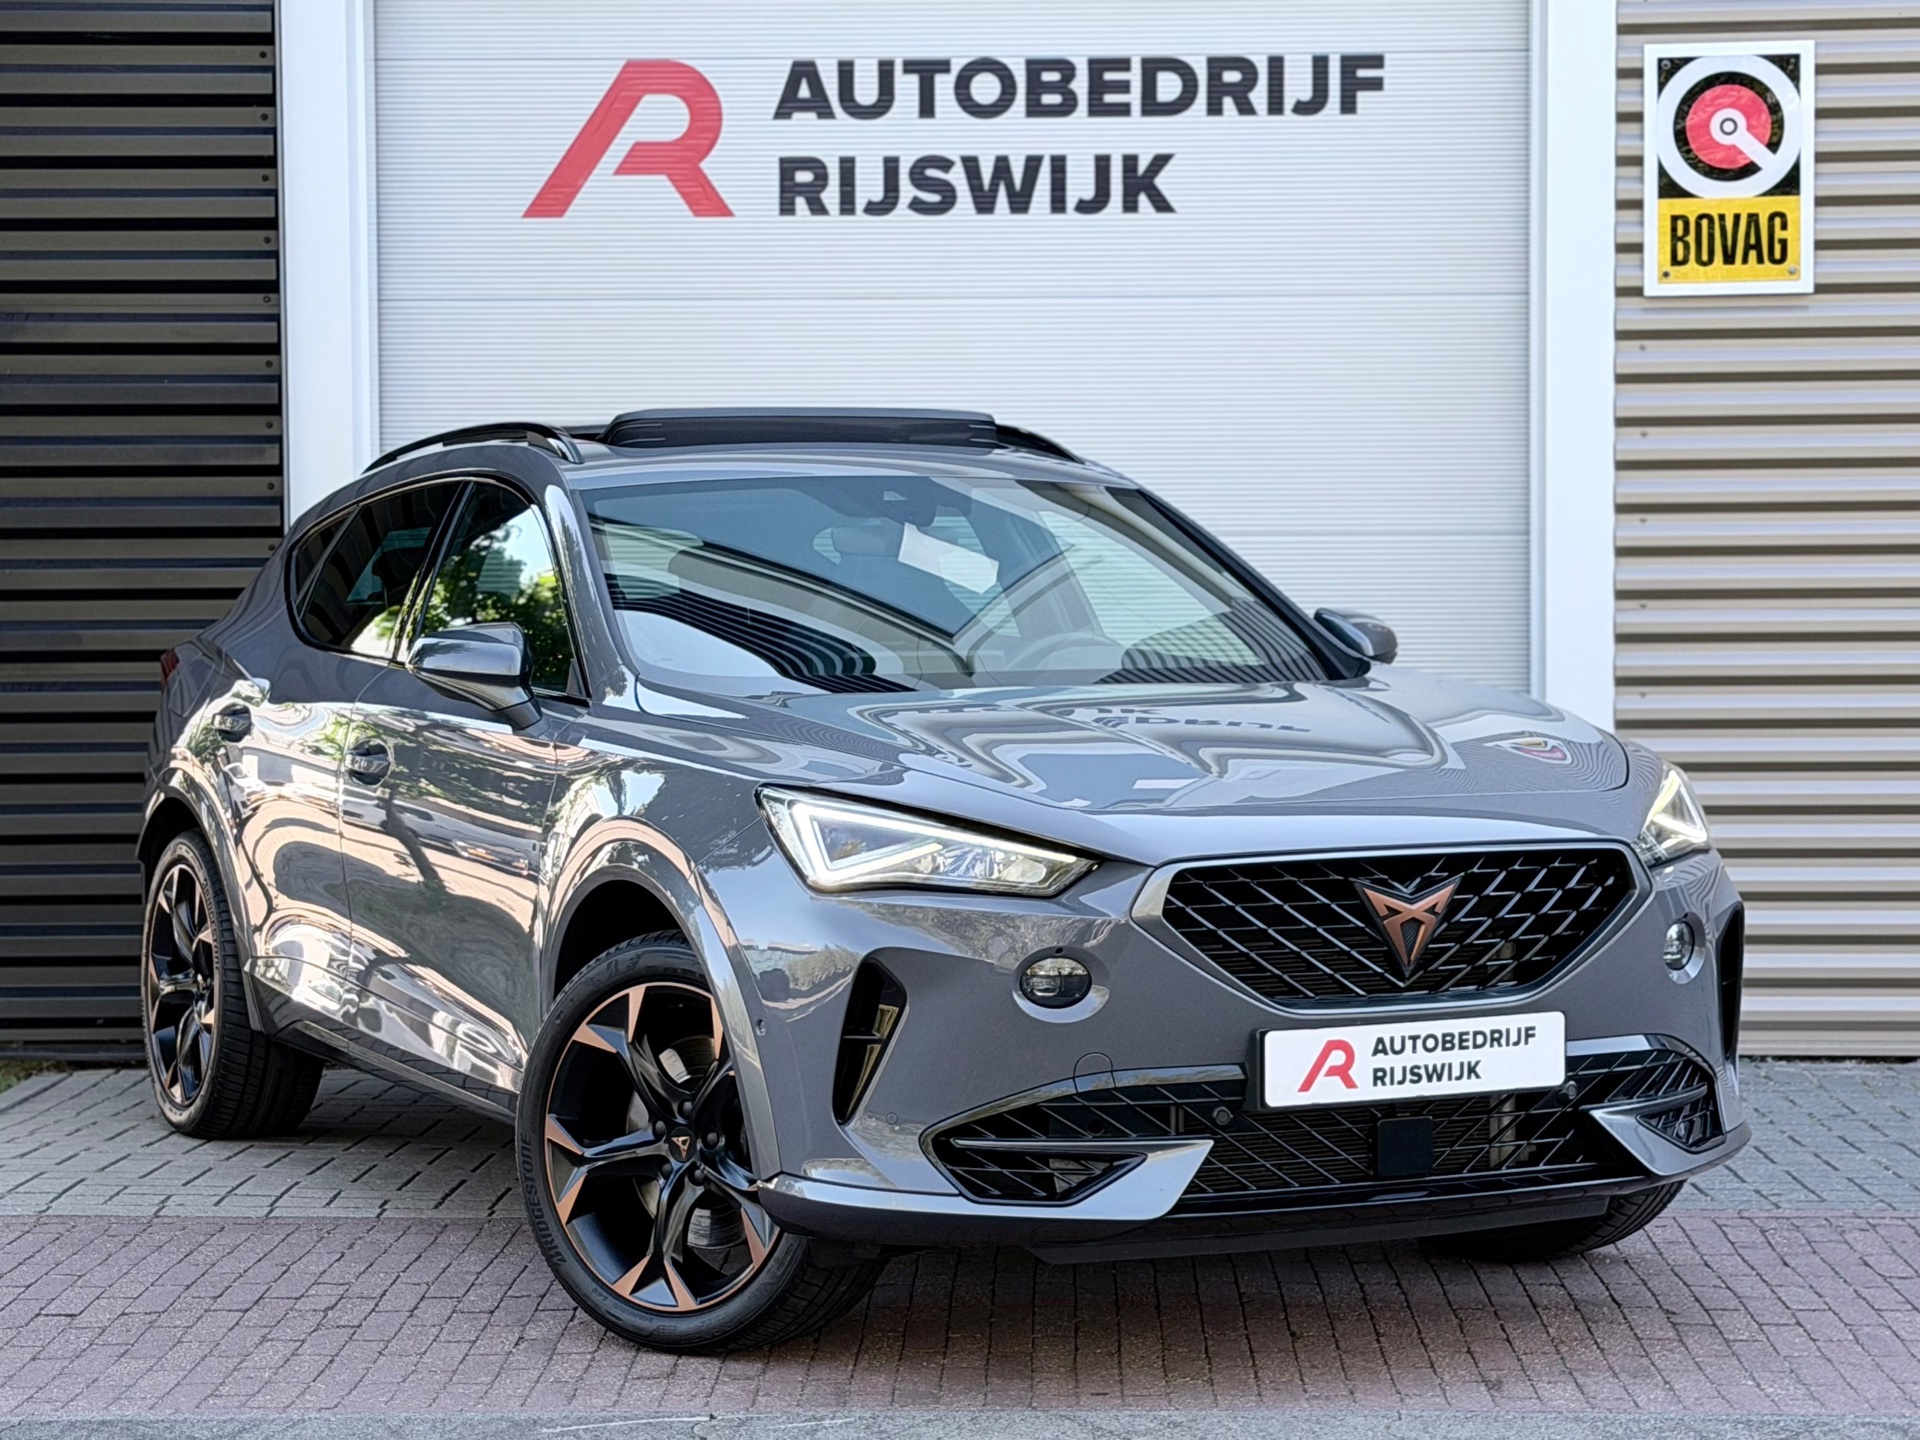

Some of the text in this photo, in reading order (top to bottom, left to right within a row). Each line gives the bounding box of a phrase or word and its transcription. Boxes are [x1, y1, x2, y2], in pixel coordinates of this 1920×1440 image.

[773, 53, 1385, 120] AUTOBEDRIJF
[778, 153, 1177, 216] RIJSWIJK
[1670, 211, 1788, 267] BOVAG
[1371, 1026, 1537, 1057] AUTOBEDRIJF
[1372, 1060, 1483, 1087] RIJSWIJK
[519, 1132, 567, 1265] BRIDGESTONE
